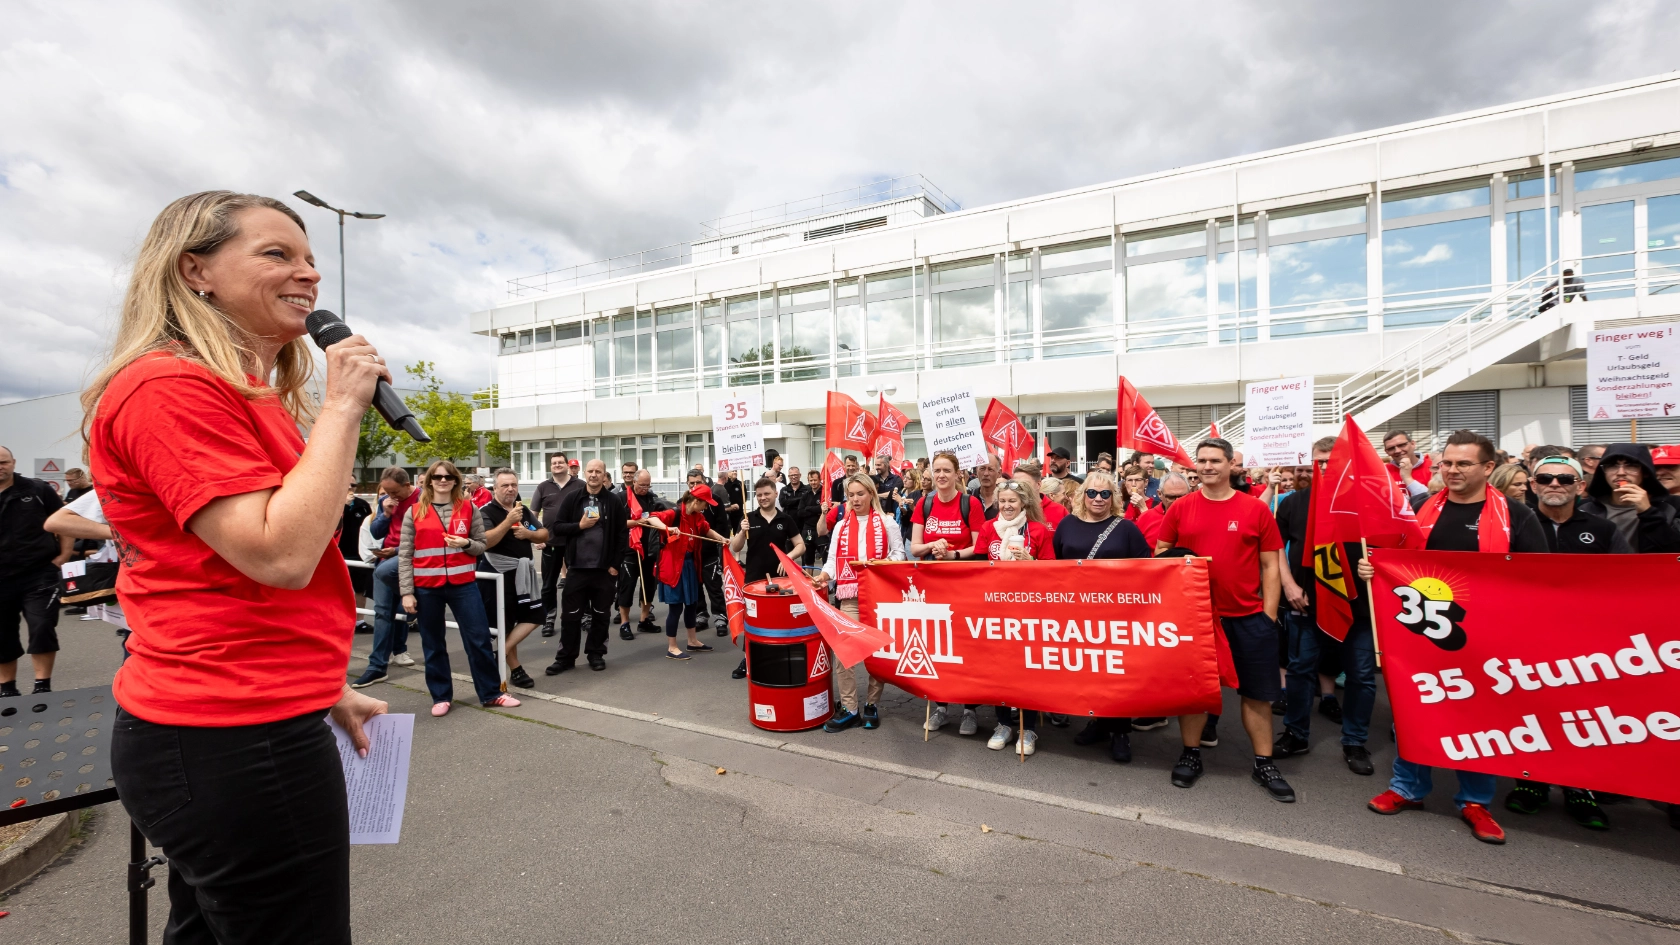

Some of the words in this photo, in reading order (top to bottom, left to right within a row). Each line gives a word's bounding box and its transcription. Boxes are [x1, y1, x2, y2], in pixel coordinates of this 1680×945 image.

[1595, 333, 1633, 342] Finger
[1637, 330, 1664, 338] weg
[1628, 353, 1649, 361] Geld
[1607, 362, 1660, 371] Urlaubsgeld
[1598, 372, 1670, 382] Weihnachtsgeld
[1251, 385, 1279, 394] Finger
[1281, 382, 1301, 390] weg
[1596, 382, 1672, 391] Sonderzahlungen
[922, 391, 970, 409] Arbeitsplatz
[1615, 391, 1652, 399] bleiben!
[724, 401, 748, 421] 35
[935, 405, 960, 417] erhalt
[1258, 412, 1297, 420] Urlaubsgeld
[935, 421, 944, 429] in
[945, 416, 966, 427] allen
[1252, 422, 1303, 432] Weihnachtsgeld
[933, 430, 975, 446] deutschen
[1250, 431, 1305, 440] Sonderzahlungen
[722, 443, 752, 454] bleiben
[873, 516, 882, 559] GEWINNT
[984, 592, 1075, 603] MERCEDES-BENZ
[1079, 592, 1115, 604] WERK
[1117, 593, 1162, 604] BERLIN
[1393, 586, 1451, 639] 35
[965, 616, 1194, 648] VERTRAUENS-
[1024, 646, 1125, 675] LEUTE
[1411, 667, 1475, 704] 35
[1440, 714, 1553, 761] und
